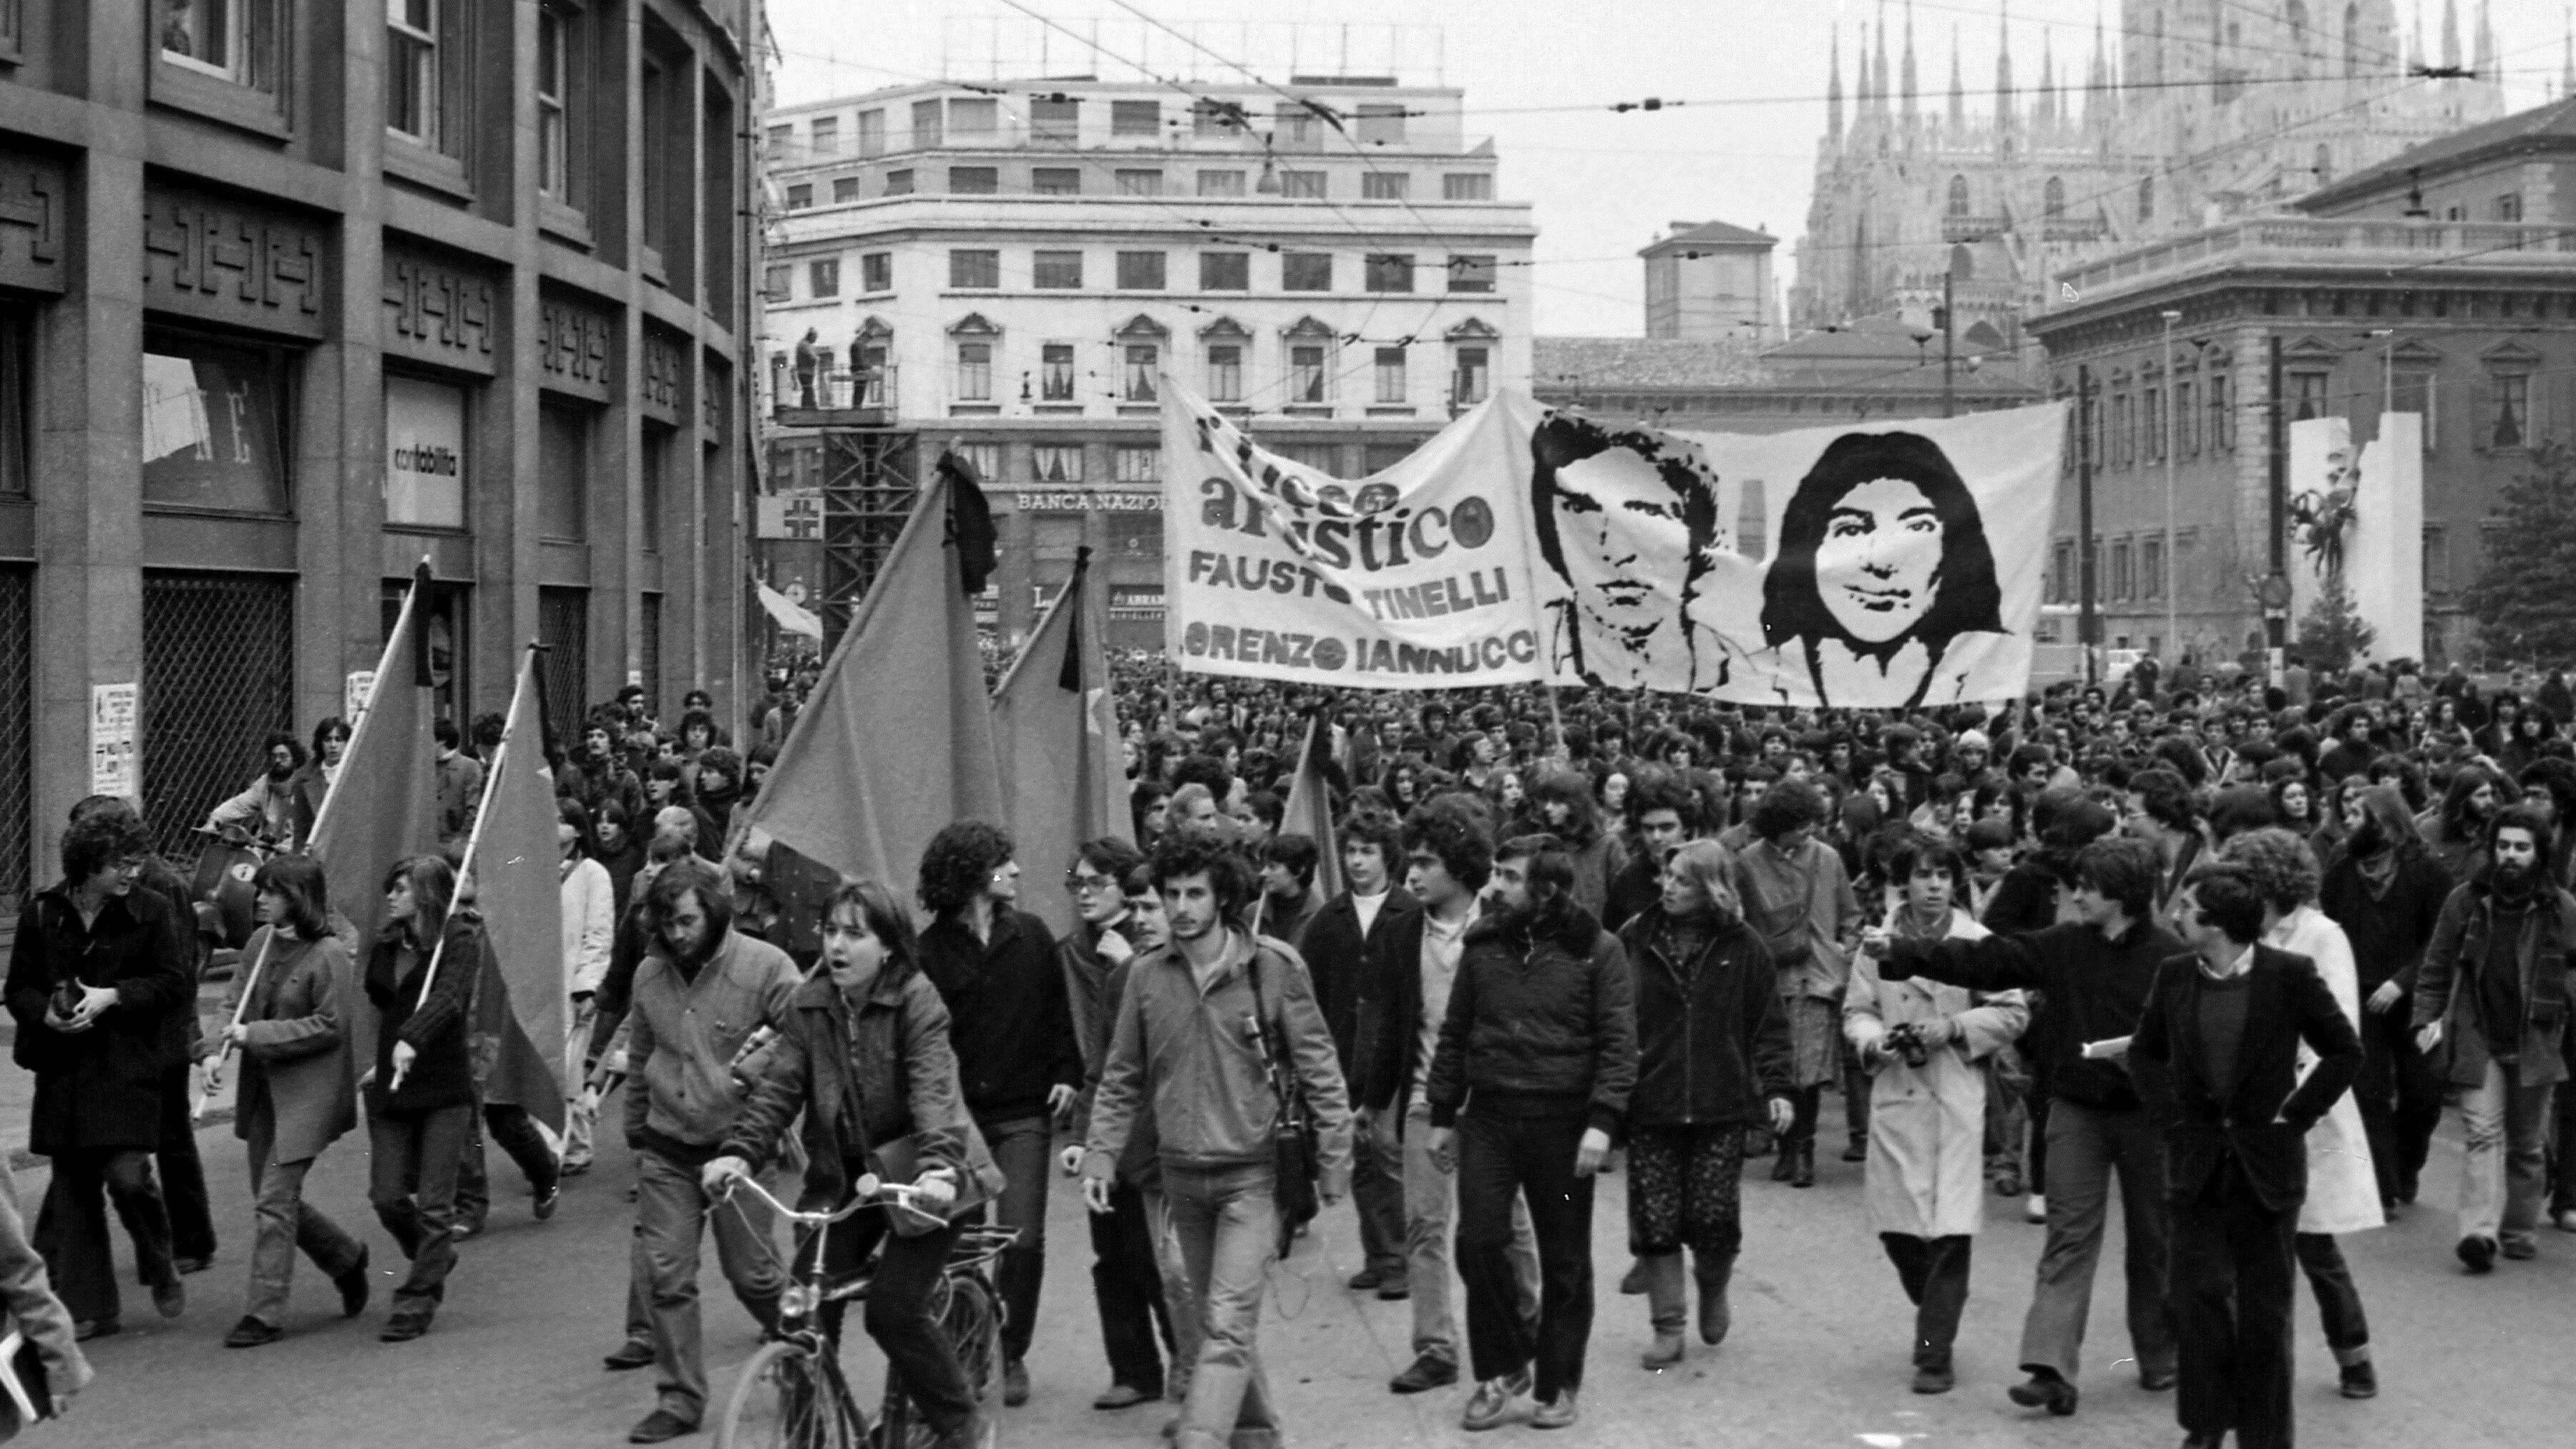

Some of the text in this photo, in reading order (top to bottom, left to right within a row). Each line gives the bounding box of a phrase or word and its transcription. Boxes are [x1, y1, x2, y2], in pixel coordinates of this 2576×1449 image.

[1018, 494, 1090, 510] BANCA
[1201, 477, 1495, 572] aristico
[1362, 567, 1508, 620] TINELLI
[1179, 621, 1347, 670] ORENZO
